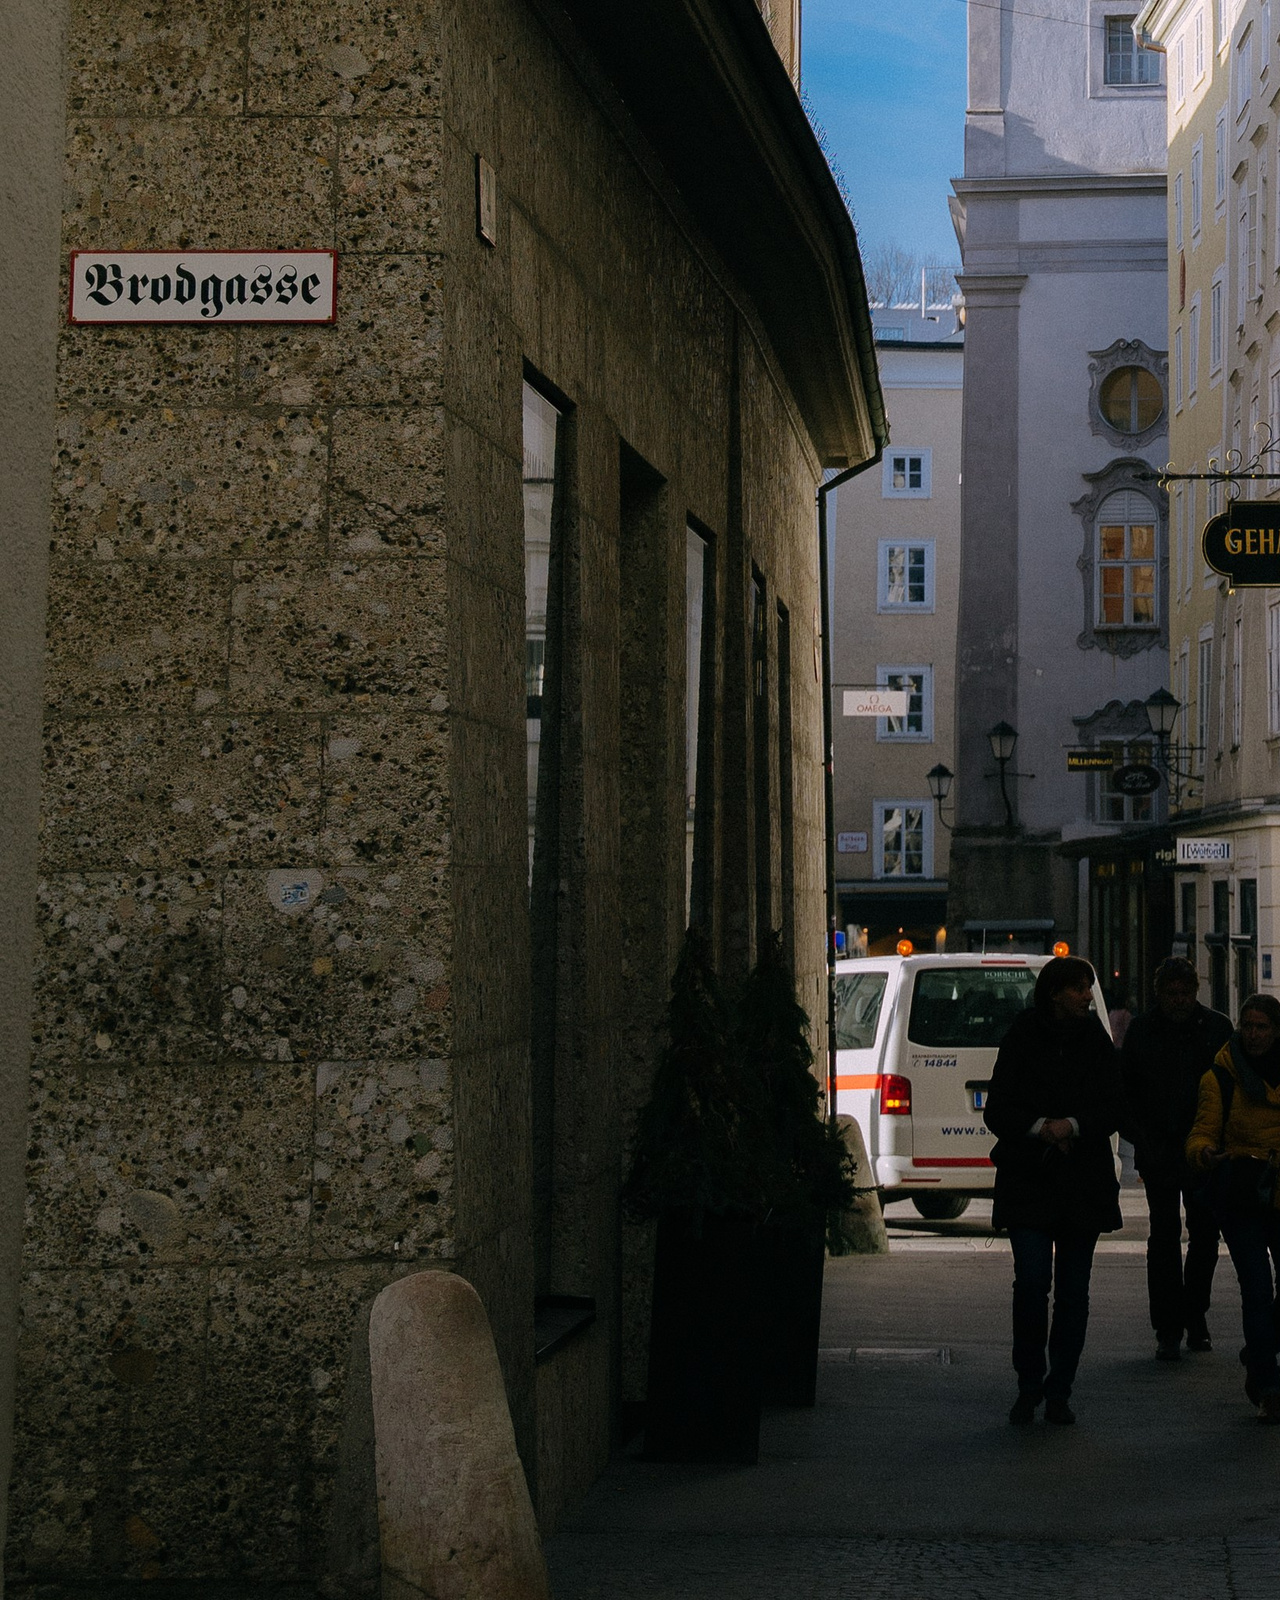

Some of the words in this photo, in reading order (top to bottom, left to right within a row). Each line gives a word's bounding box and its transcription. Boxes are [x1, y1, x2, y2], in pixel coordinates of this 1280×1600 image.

[85, 262, 322, 318] Brodgasse
[856, 704, 893, 713] OMEGA
[984, 971, 1028, 979] PORSCHE
[924, 1059, 957, 1067] 14844
